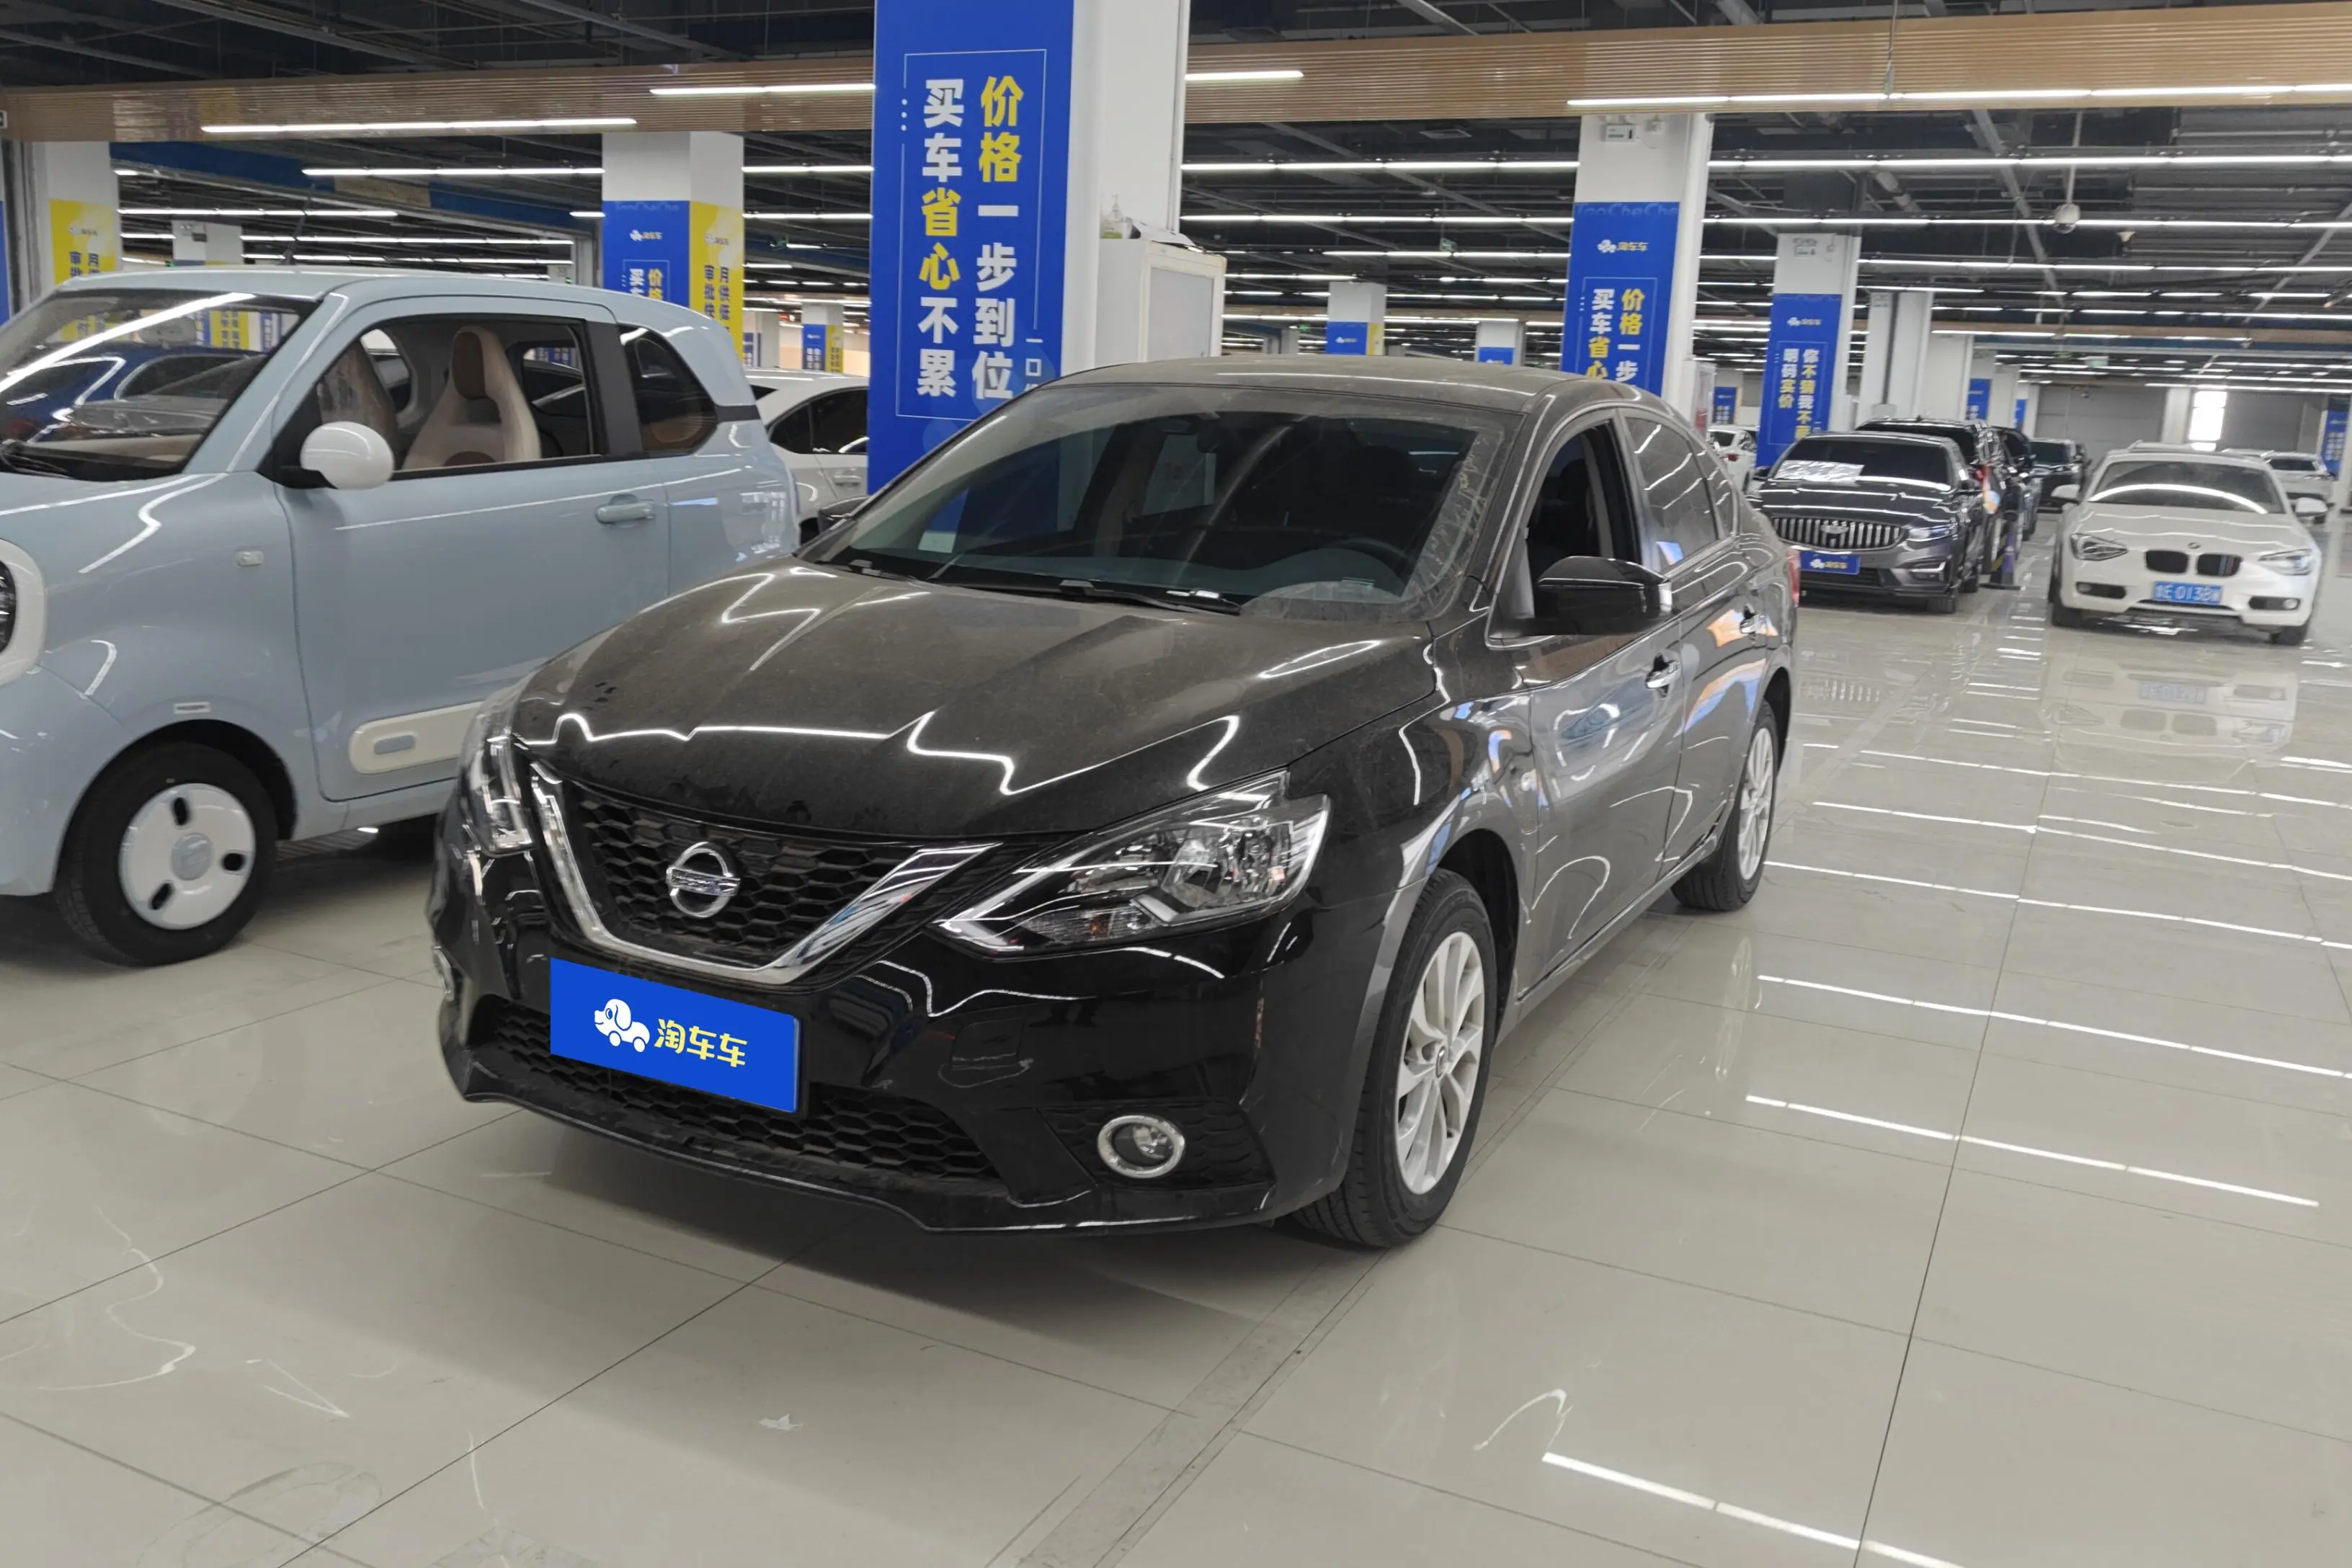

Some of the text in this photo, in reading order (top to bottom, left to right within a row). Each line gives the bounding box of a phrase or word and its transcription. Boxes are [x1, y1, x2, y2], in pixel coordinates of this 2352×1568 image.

[917, 79, 964, 398] 买车省心不累
[972, 76, 1024, 399] 价格一步到位
[1024, 338, 1043, 392] 一口
[1586, 288, 1615, 379] 买车省心
[1616, 288, 1645, 383] 价格一步
